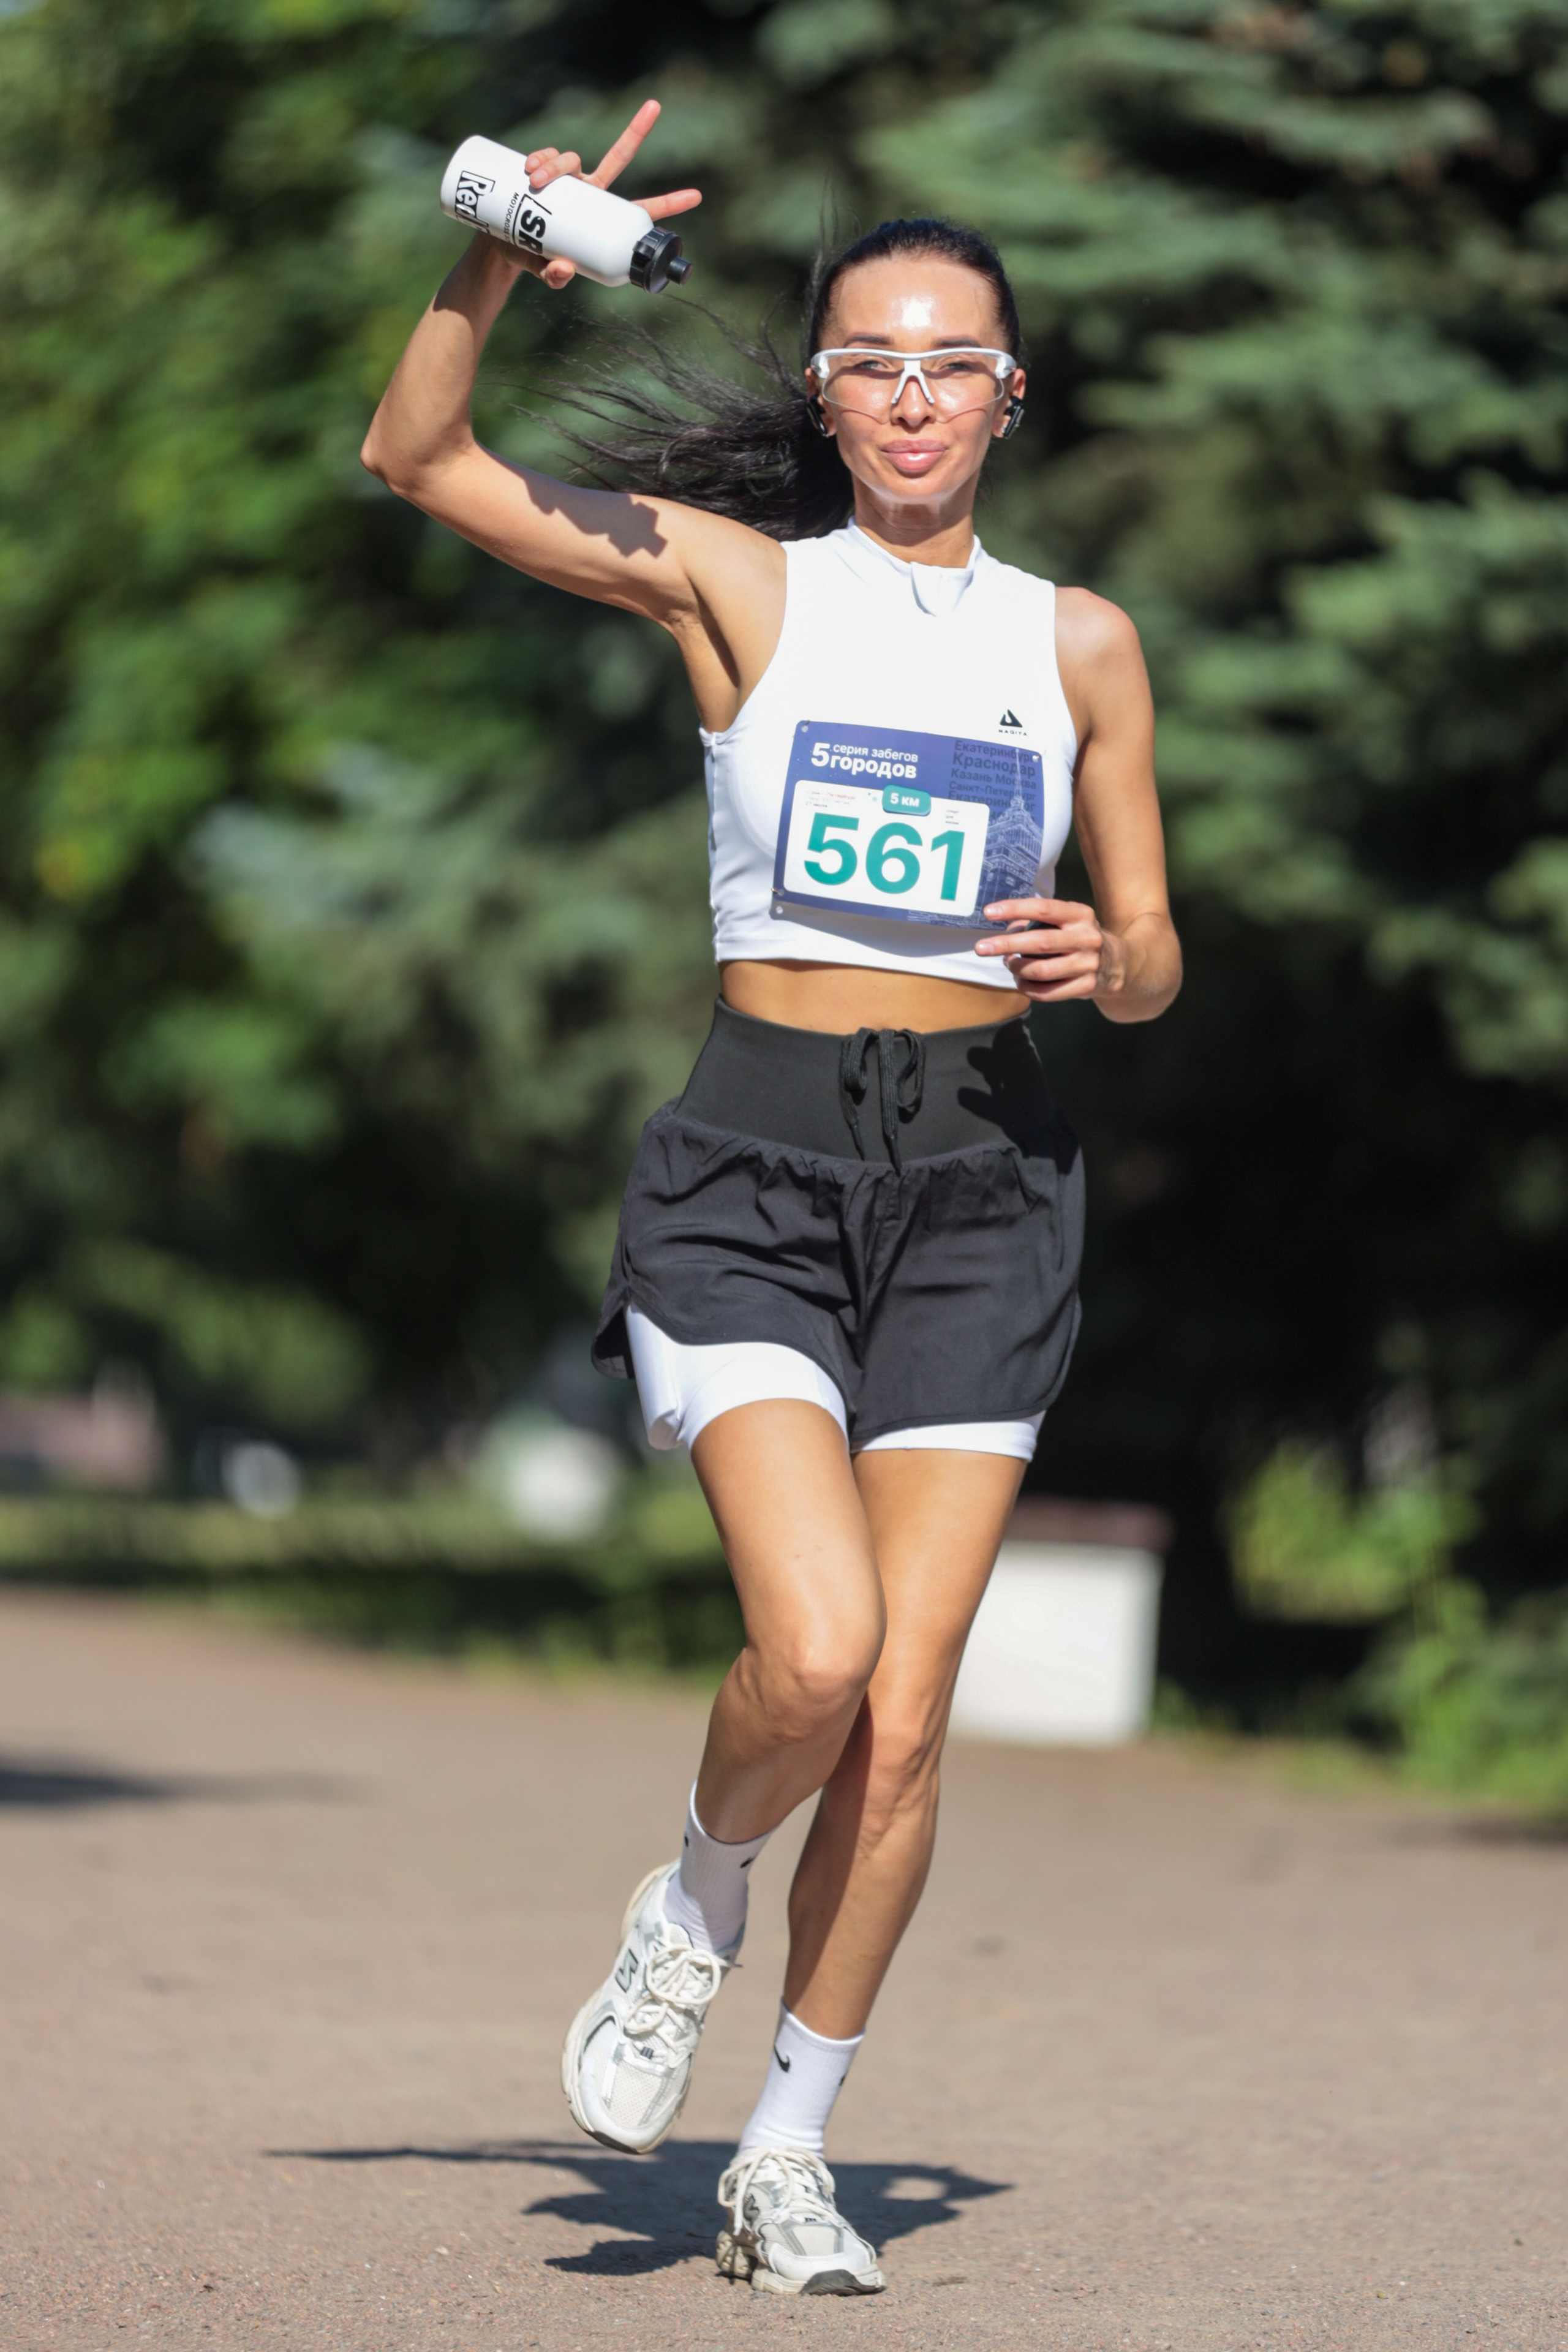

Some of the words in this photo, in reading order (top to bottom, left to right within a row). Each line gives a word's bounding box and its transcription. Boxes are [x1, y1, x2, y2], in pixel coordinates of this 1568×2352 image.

[503, 192, 520, 238] MOTOCROSS
[811, 742, 831, 767] 5
[830, 755, 918, 779] городов
[833, 744, 869, 756] серия
[871, 748, 918, 763] забегов
[952, 752, 1036, 779] Краснодар
[951, 768, 993, 783] Казань
[890, 793, 899, 804] 5
[901, 797, 920, 807] км
[949, 780, 1036, 801] Санкт-Петерург
[804, 812, 965, 902] 561
